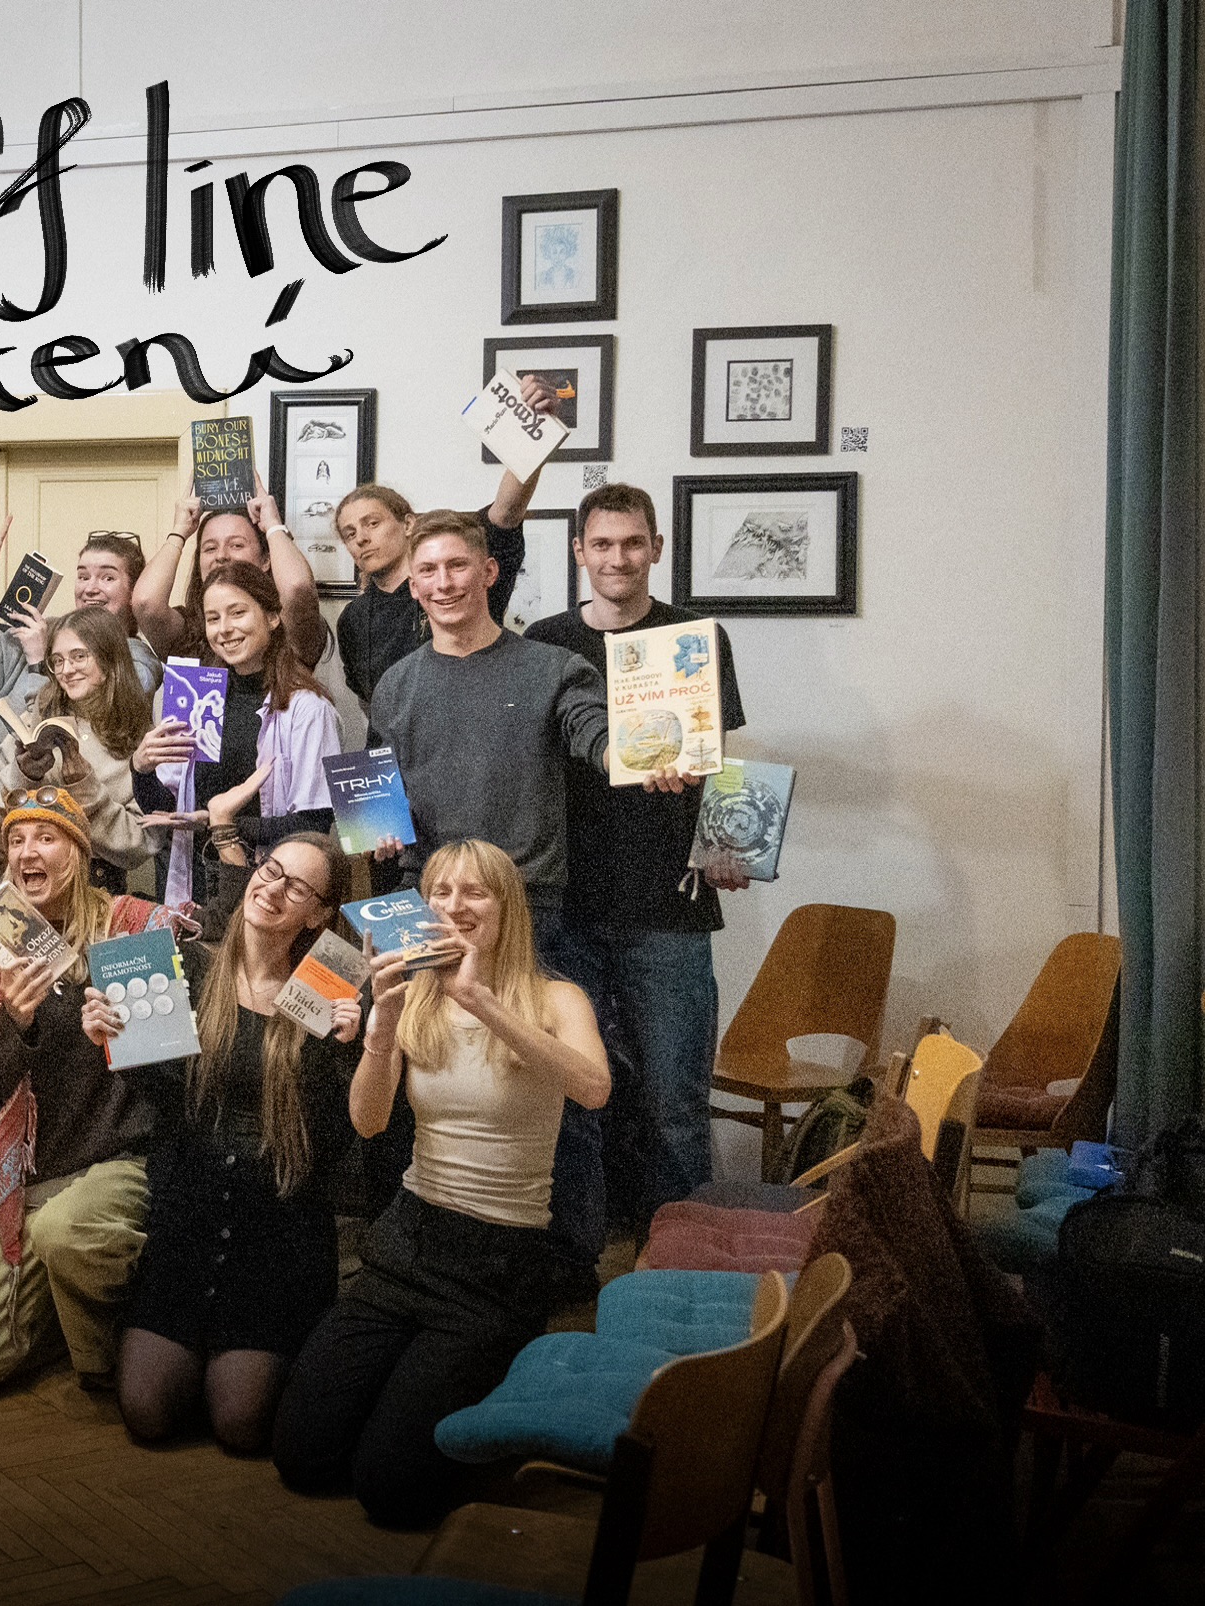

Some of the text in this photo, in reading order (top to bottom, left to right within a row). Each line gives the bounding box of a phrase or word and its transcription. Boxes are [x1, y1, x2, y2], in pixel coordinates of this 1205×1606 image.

[491, 382, 546, 441] Kmotr
[195, 420, 247, 435] BURY OUR
[196, 432, 240, 450] BONES
[196, 447, 249, 463] MIDNIGHT
[196, 462, 231, 478] SOIL
[200, 492, 253, 506] SCHWAB
[615, 681, 712, 706] UŽ VÍM PROČ
[333, 771, 396, 792] TRHY
[26, 926, 54, 952] Obraz
[101, 955, 147, 972] INFORMAČNÍ
[102, 963, 152, 979] GRAMOTNOST
[279, 996, 307, 1020] jídla
[287, 985, 323, 1016] Vládci
